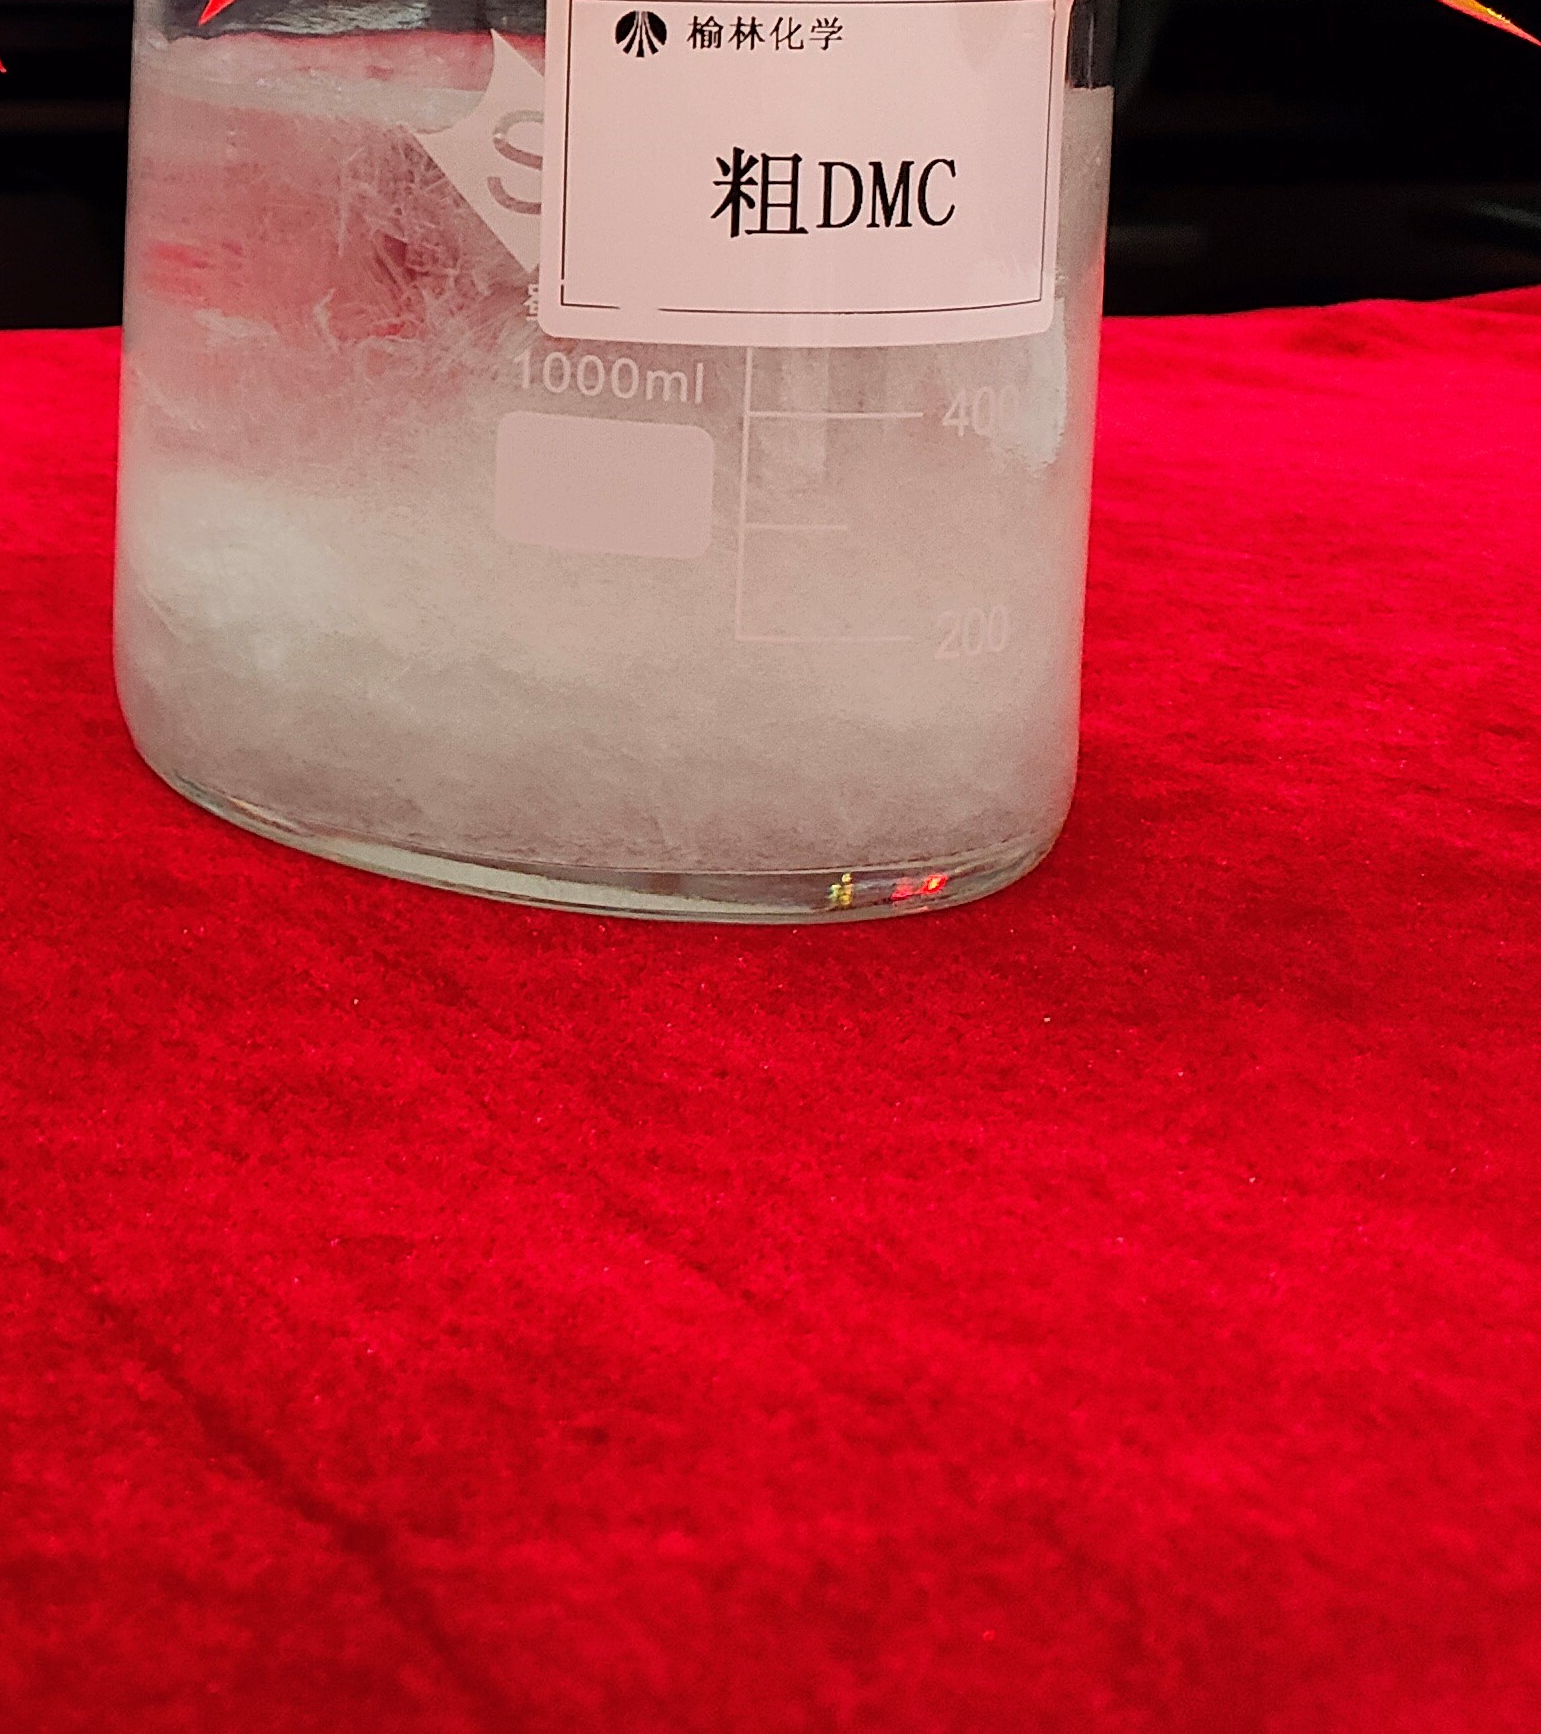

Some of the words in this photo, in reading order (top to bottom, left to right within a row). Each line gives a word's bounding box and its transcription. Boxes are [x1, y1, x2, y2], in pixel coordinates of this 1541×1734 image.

[687, 15, 844, 52] 榆林化学
[710, 146, 958, 240] 粗DMC
[511, 348, 705, 405] 1000ml
[941, 382, 1021, 439] 400
[933, 601, 1012, 663] 200
